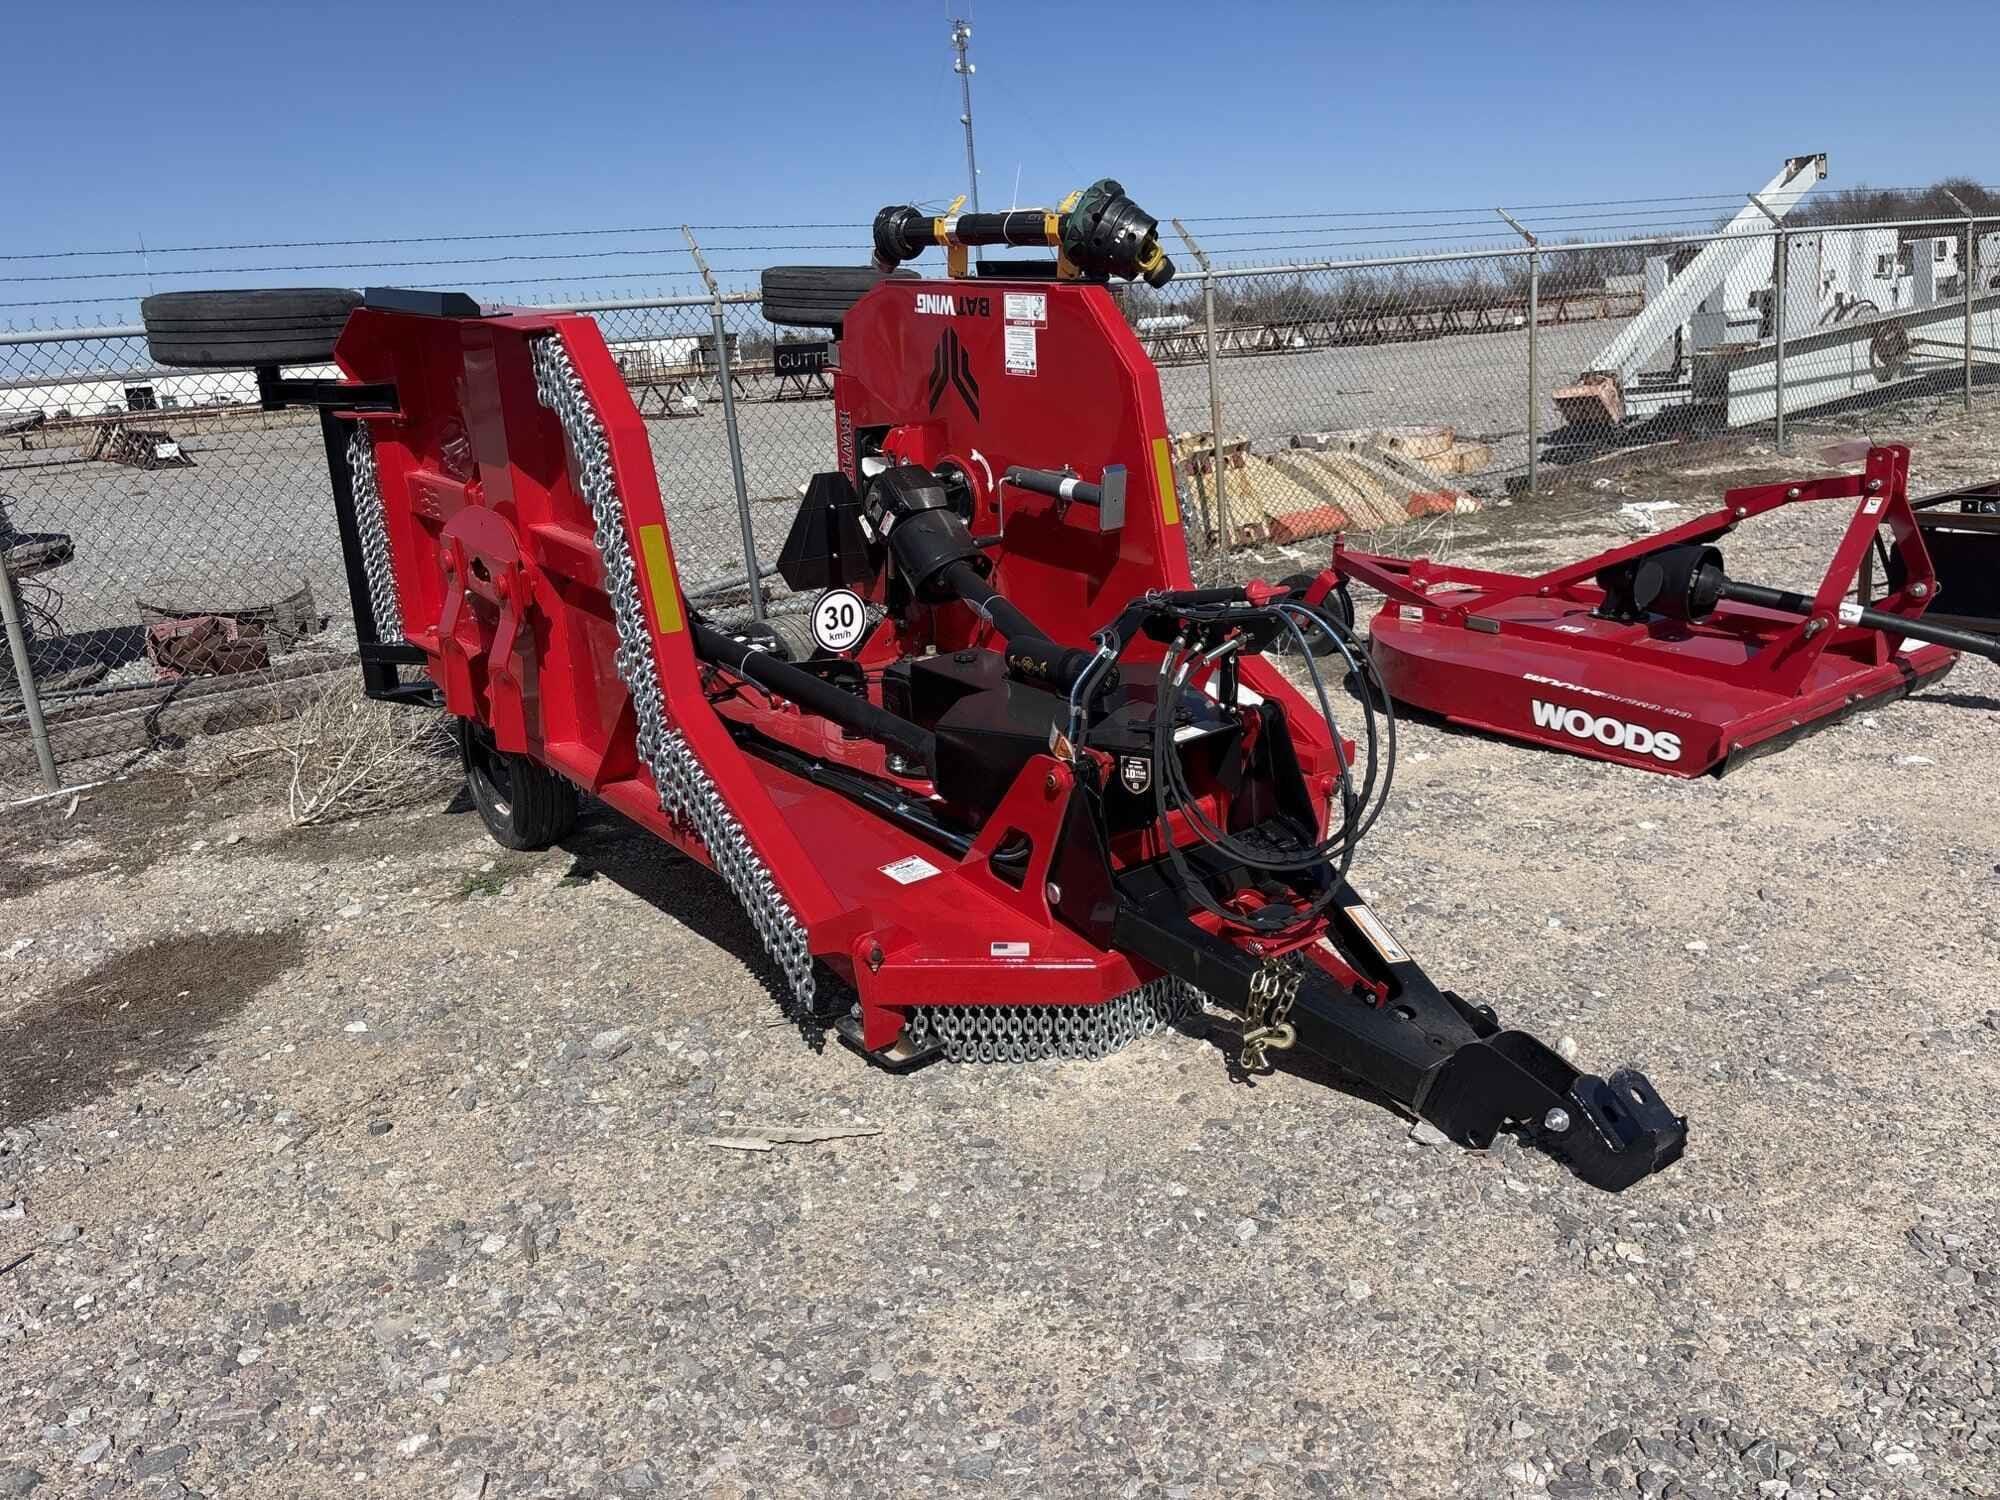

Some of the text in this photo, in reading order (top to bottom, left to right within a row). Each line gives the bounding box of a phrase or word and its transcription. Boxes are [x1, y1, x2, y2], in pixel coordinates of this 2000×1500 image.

[914, 293, 990, 317] BATWING
[824, 603, 854, 630] 30
[829, 630, 851, 641] km/h
[1531, 699, 1682, 762] WOODS
[1125, 768, 1135, 778] 10
